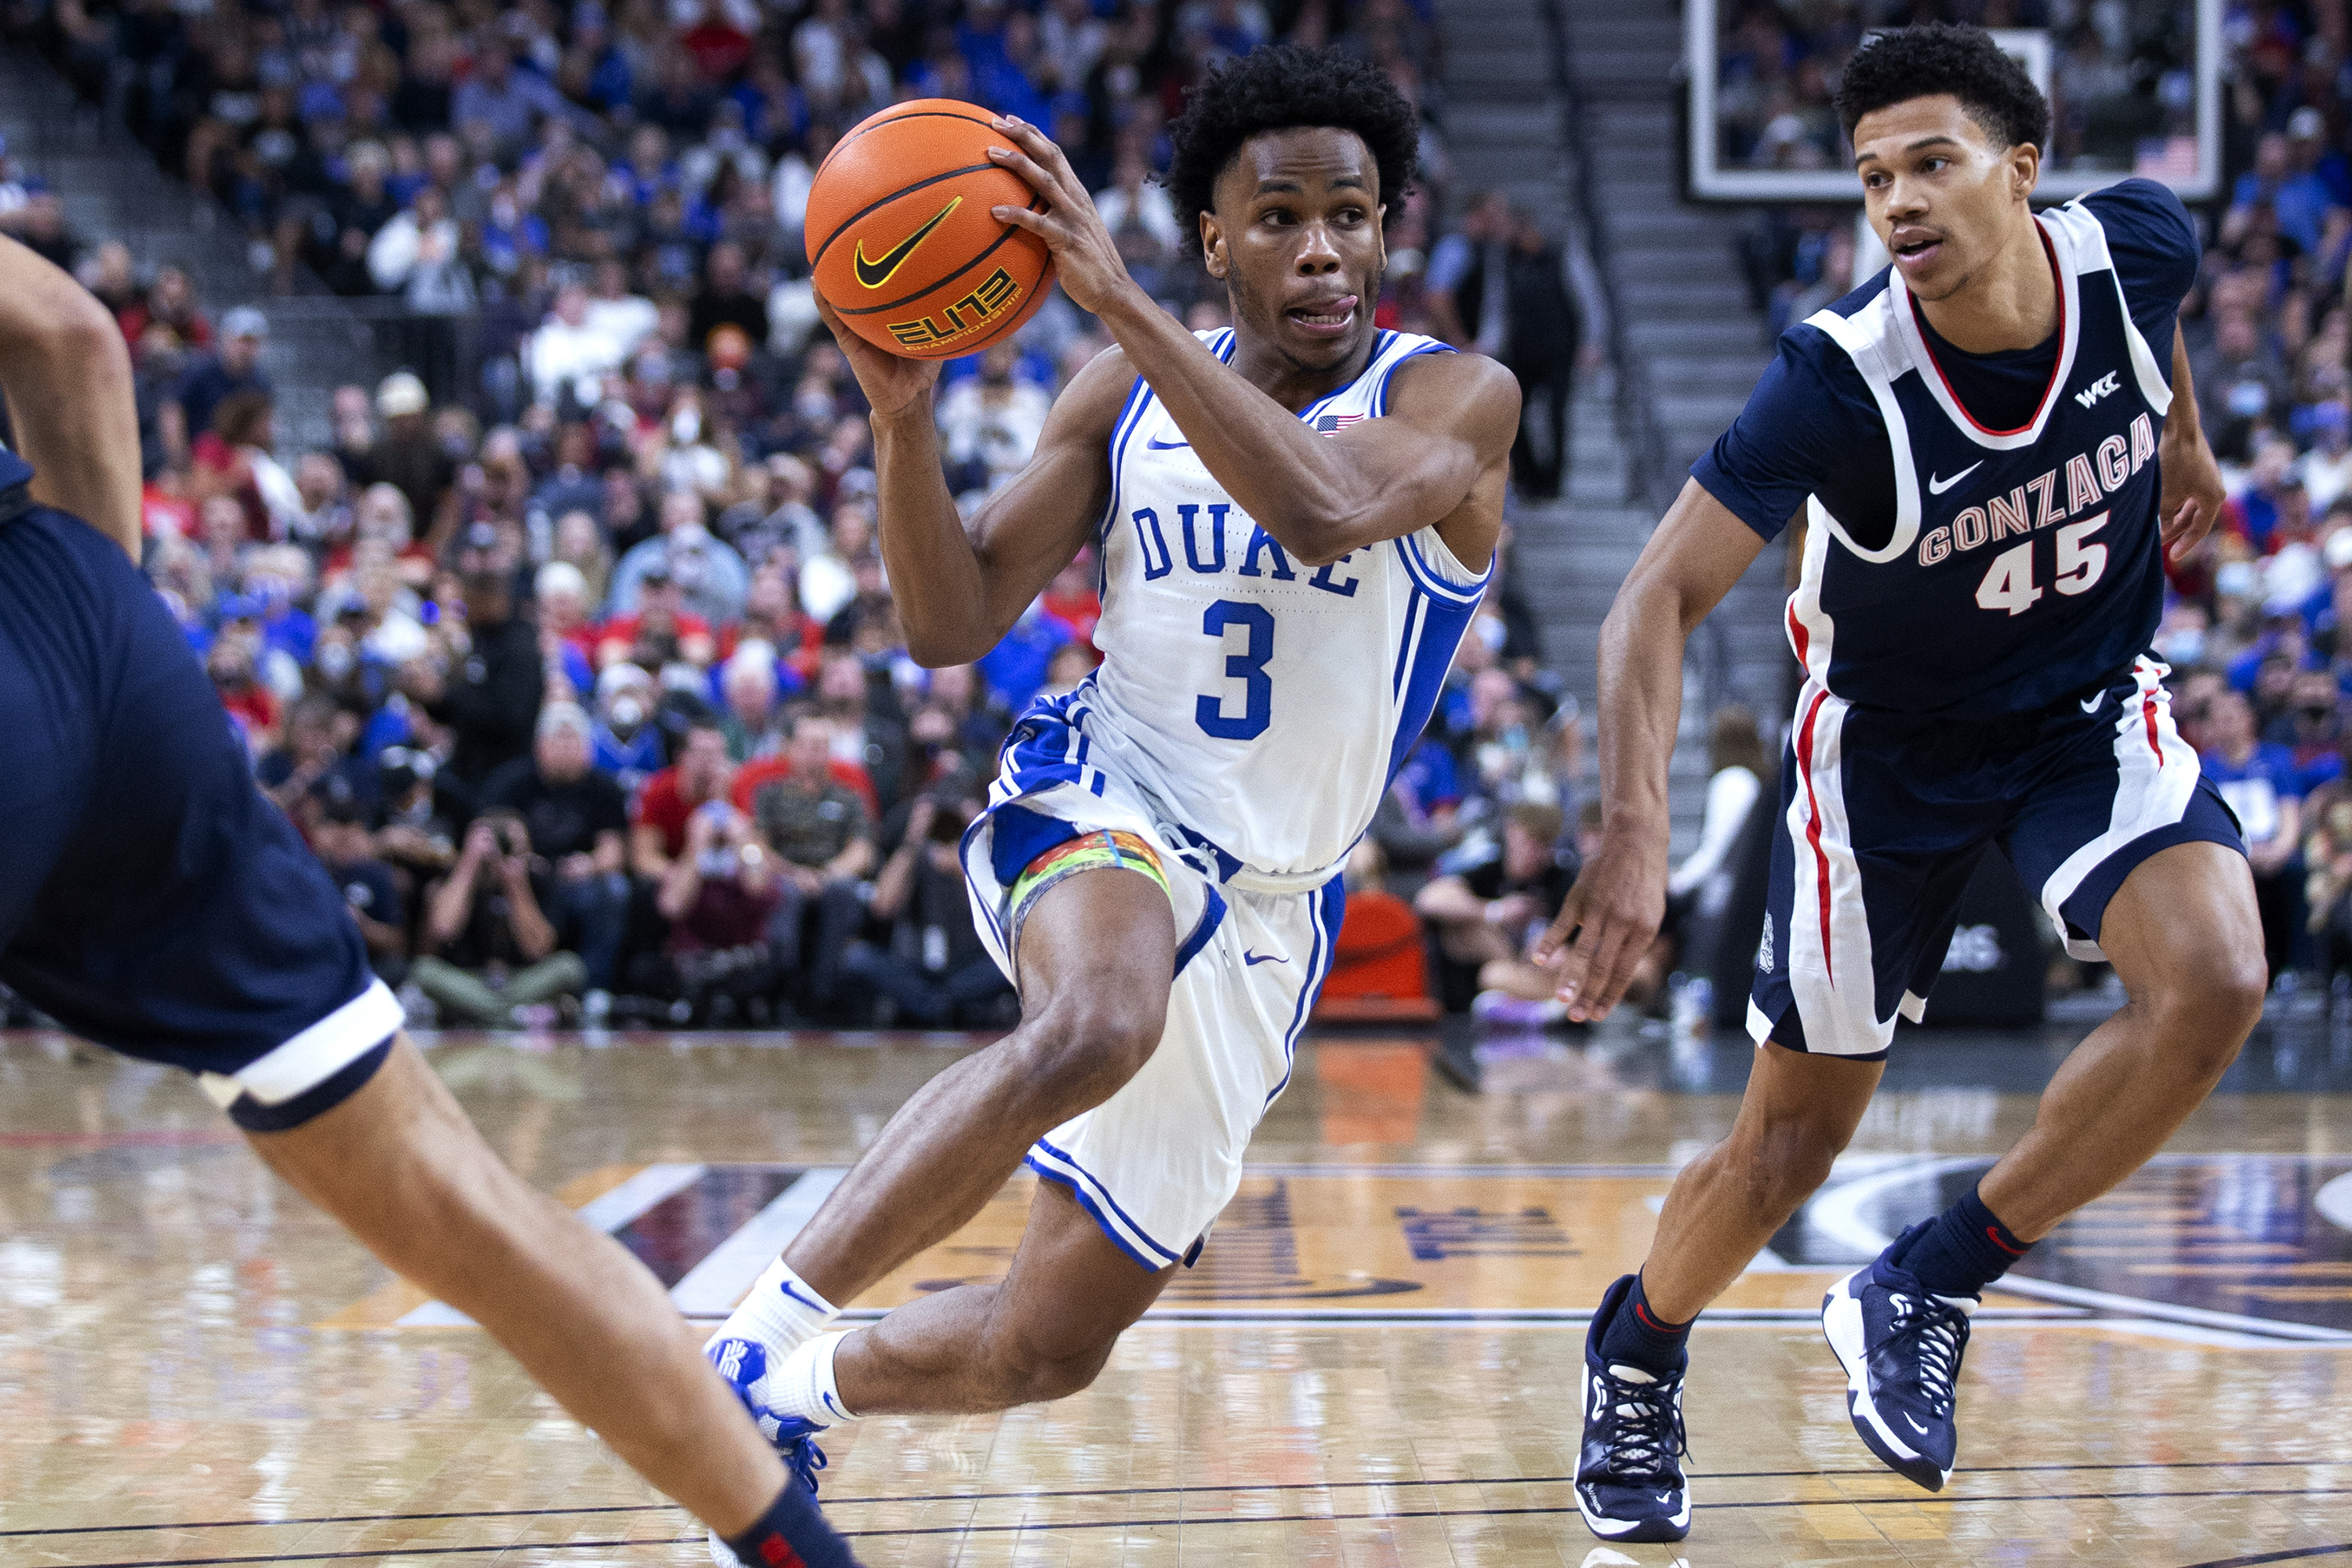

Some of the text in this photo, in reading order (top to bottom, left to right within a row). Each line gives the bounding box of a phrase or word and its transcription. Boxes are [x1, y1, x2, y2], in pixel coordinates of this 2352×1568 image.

[886, 266, 1018, 347] ELITE
[905, 288, 1022, 350] CHAMPIONSHIP
[2075, 369, 2121, 408] WCC
[1918, 411, 2155, 566] GONZAGA
[1974, 509, 2111, 616] 45
[1195, 599, 1275, 741] 3
